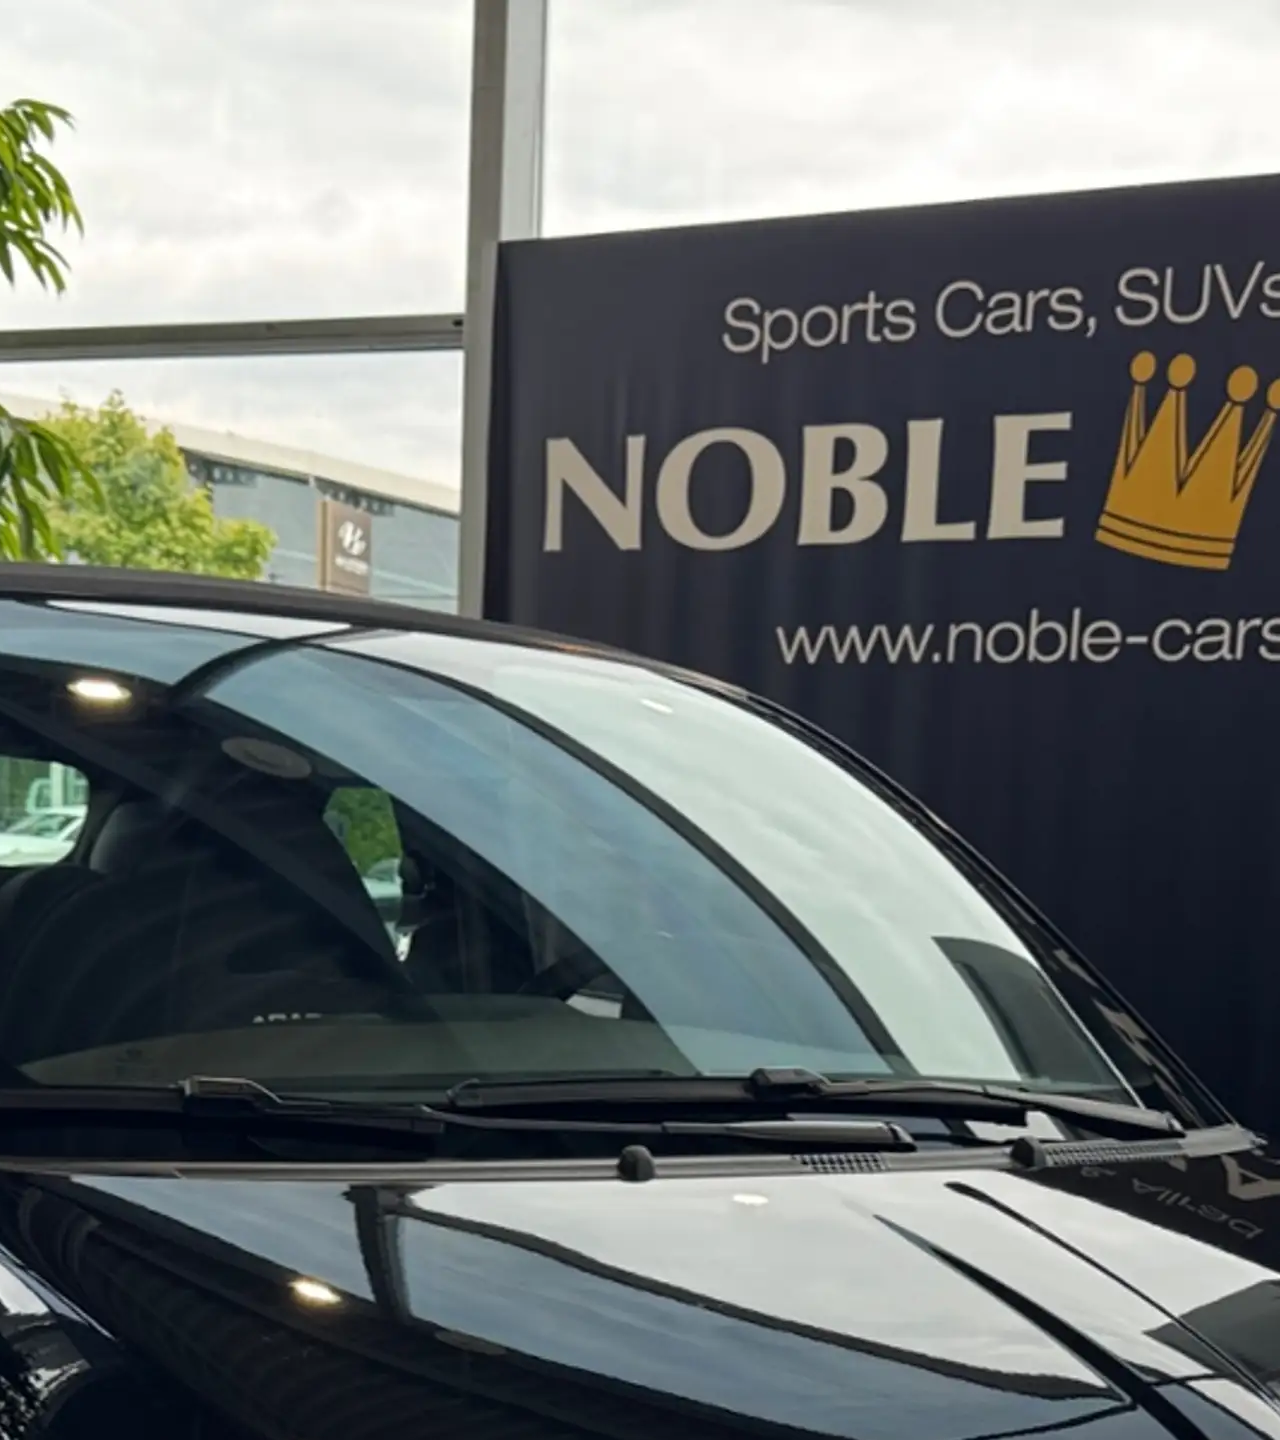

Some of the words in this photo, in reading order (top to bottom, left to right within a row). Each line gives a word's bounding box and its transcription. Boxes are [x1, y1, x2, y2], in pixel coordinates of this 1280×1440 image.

[722, 290, 917, 365] Sports
[935, 267, 1097, 338] Cars,
[543, 411, 1073, 553] NOBLE
